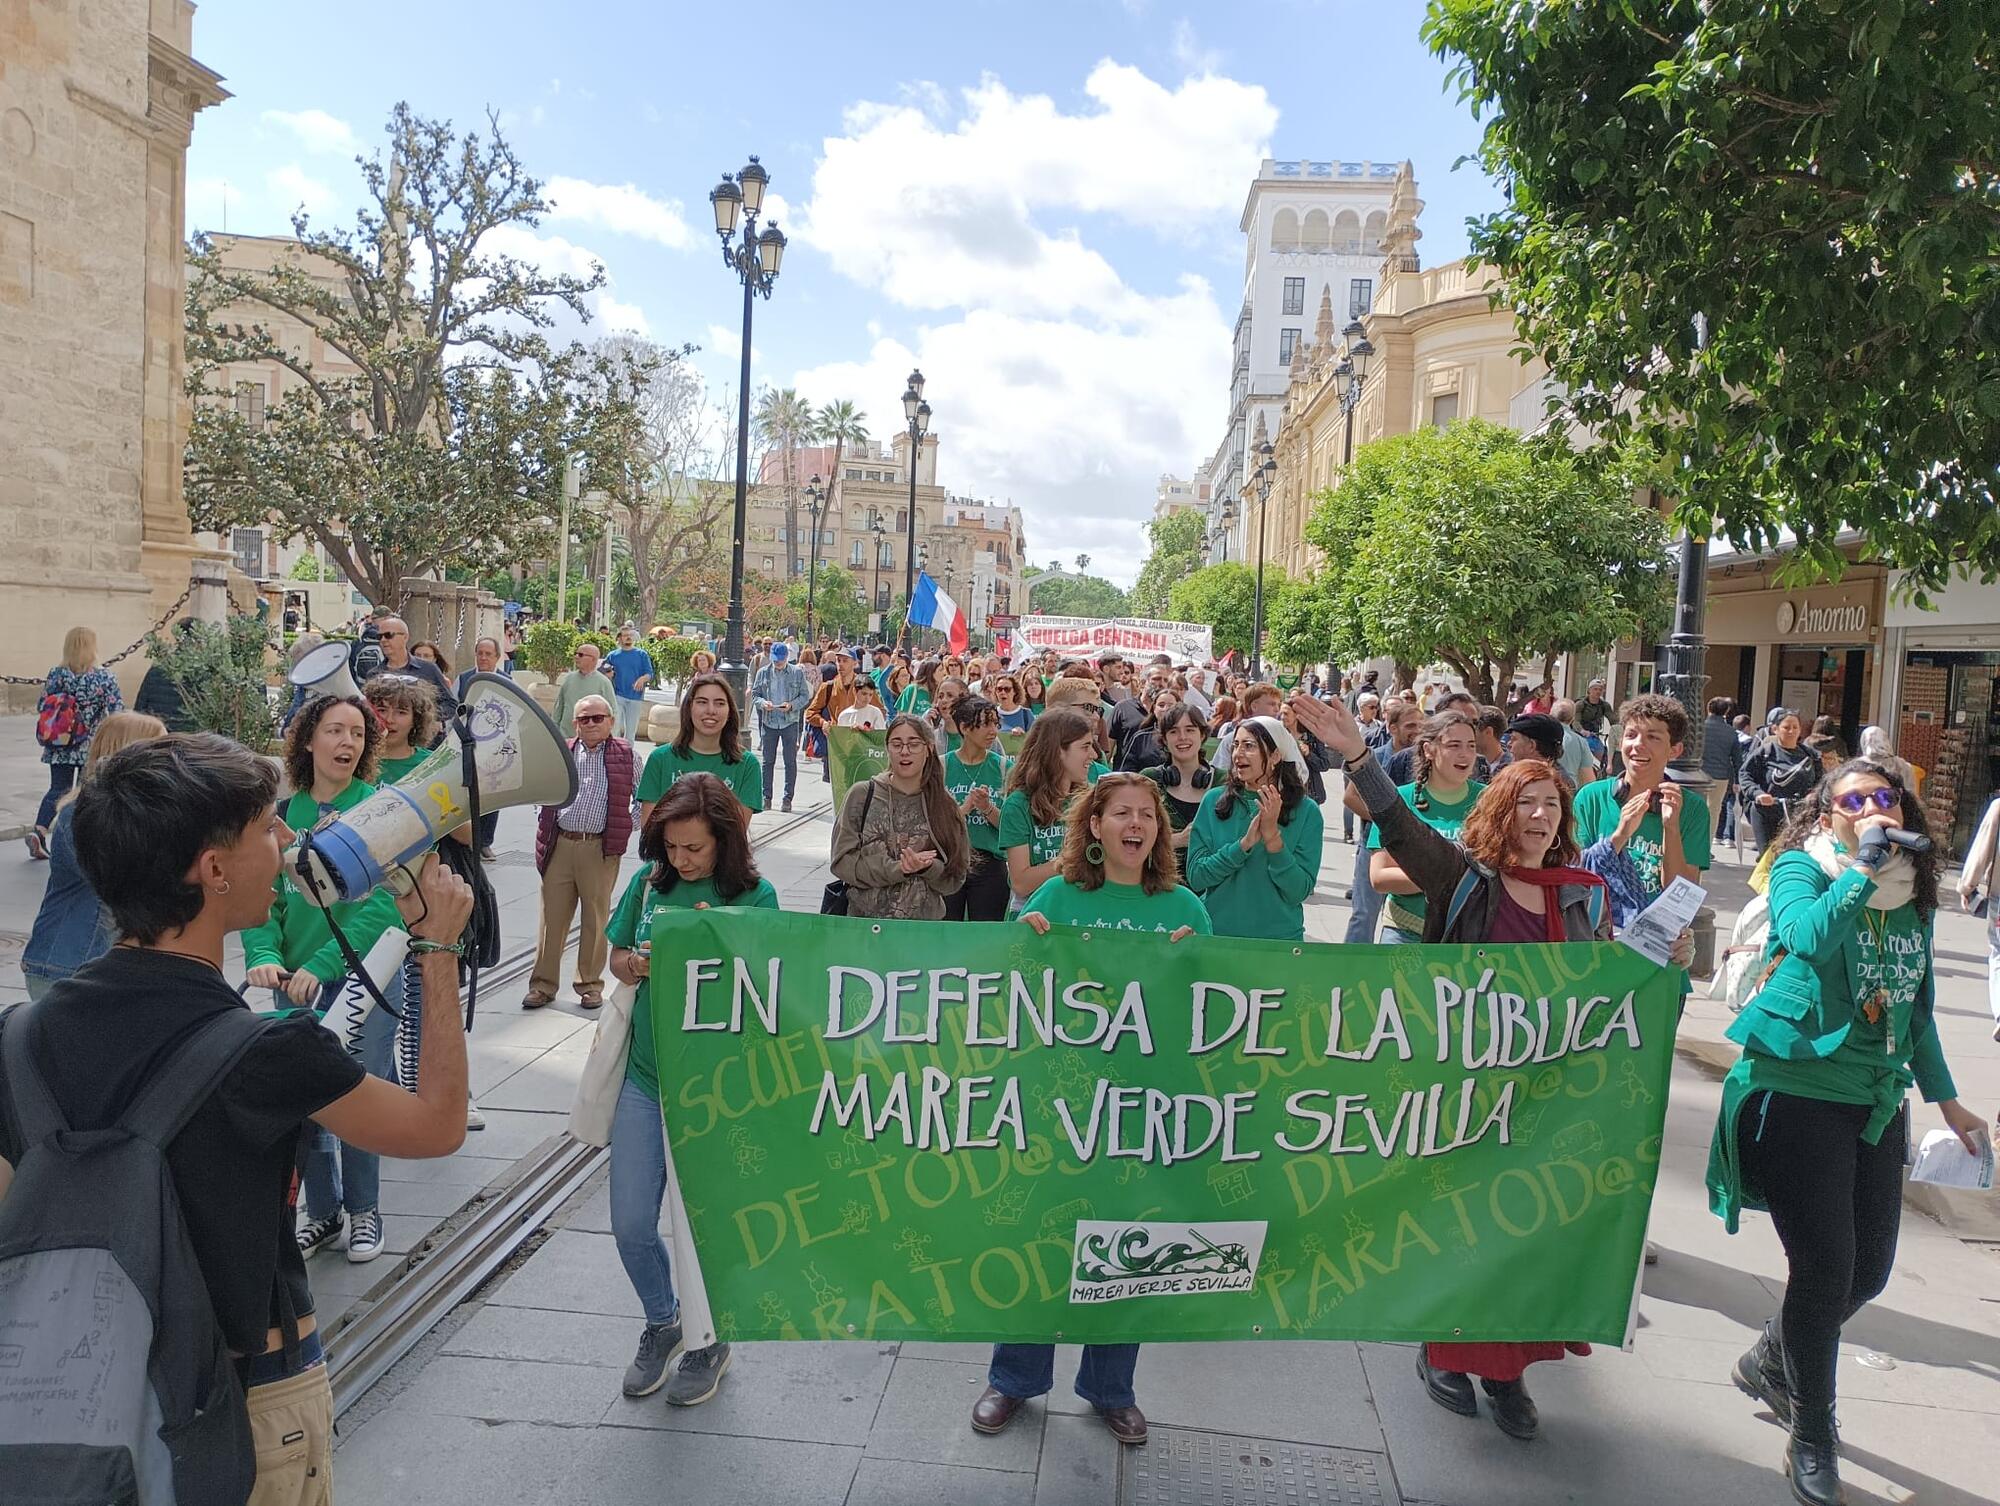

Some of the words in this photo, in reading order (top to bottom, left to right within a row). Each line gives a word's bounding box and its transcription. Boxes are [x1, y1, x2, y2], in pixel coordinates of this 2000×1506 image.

[1148, 620, 1173, 630] CALIDAD
[1174, 623, 1180, 631] Y
[1181, 623, 1206, 633] SEGURA
[1795, 596, 1866, 633] Amorino
[1094, 628, 1167, 651] GENERAL!
[868, 749, 884, 758] Por
[681, 956, 781, 1035] EN
[822, 966, 1154, 1055] DEFENSA
[1187, 981, 1287, 1055] DE
[1324, 986, 1412, 1061] LA
[1433, 968, 1641, 1070] PÚBLICA
[809, 1066, 1026, 1153] MAREA
[1053, 1078, 1261, 1166] VERDE
[1274, 1078, 1515, 1158] SEVILLA
[732, 1182, 841, 1271] DE
[1262, 1210, 1441, 1329] PARA
[1073, 1284, 1123, 1301] MAREA
[1128, 1279, 1182, 1296] VERDE
[1187, 1276, 1251, 1291] SEVILLA
